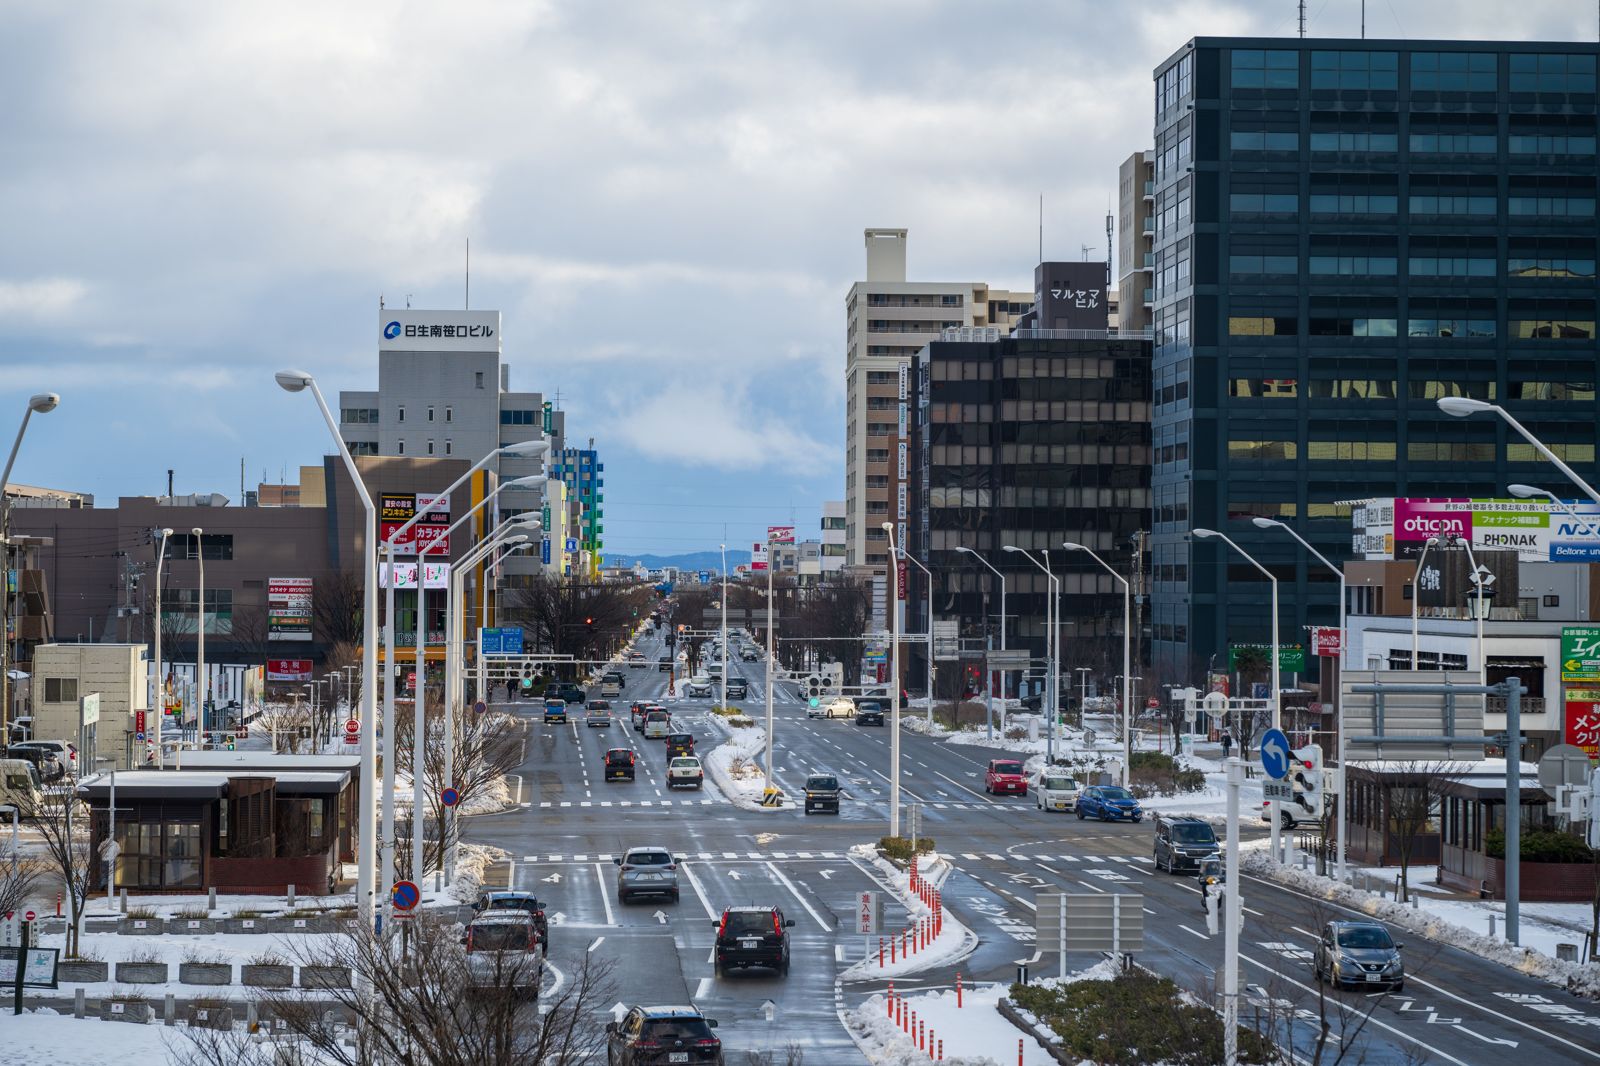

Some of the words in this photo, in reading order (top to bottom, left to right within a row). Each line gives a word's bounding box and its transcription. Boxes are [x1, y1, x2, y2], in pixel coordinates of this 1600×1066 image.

[1051, 289, 1099, 299] マルヤマ
[1075, 298, 1098, 308] ビル
[405, 325, 493, 338] 日生南笹口ビル
[385, 500, 412, 508] 驚安の殿堂
[1404, 516, 1463, 531] oticon
[1482, 516, 1540, 525] フォナック補聴器
[1484, 534, 1537, 545] PHONAK
[1556, 547, 1586, 555] Beltone
[861, 894, 870, 932] 進入禁止
